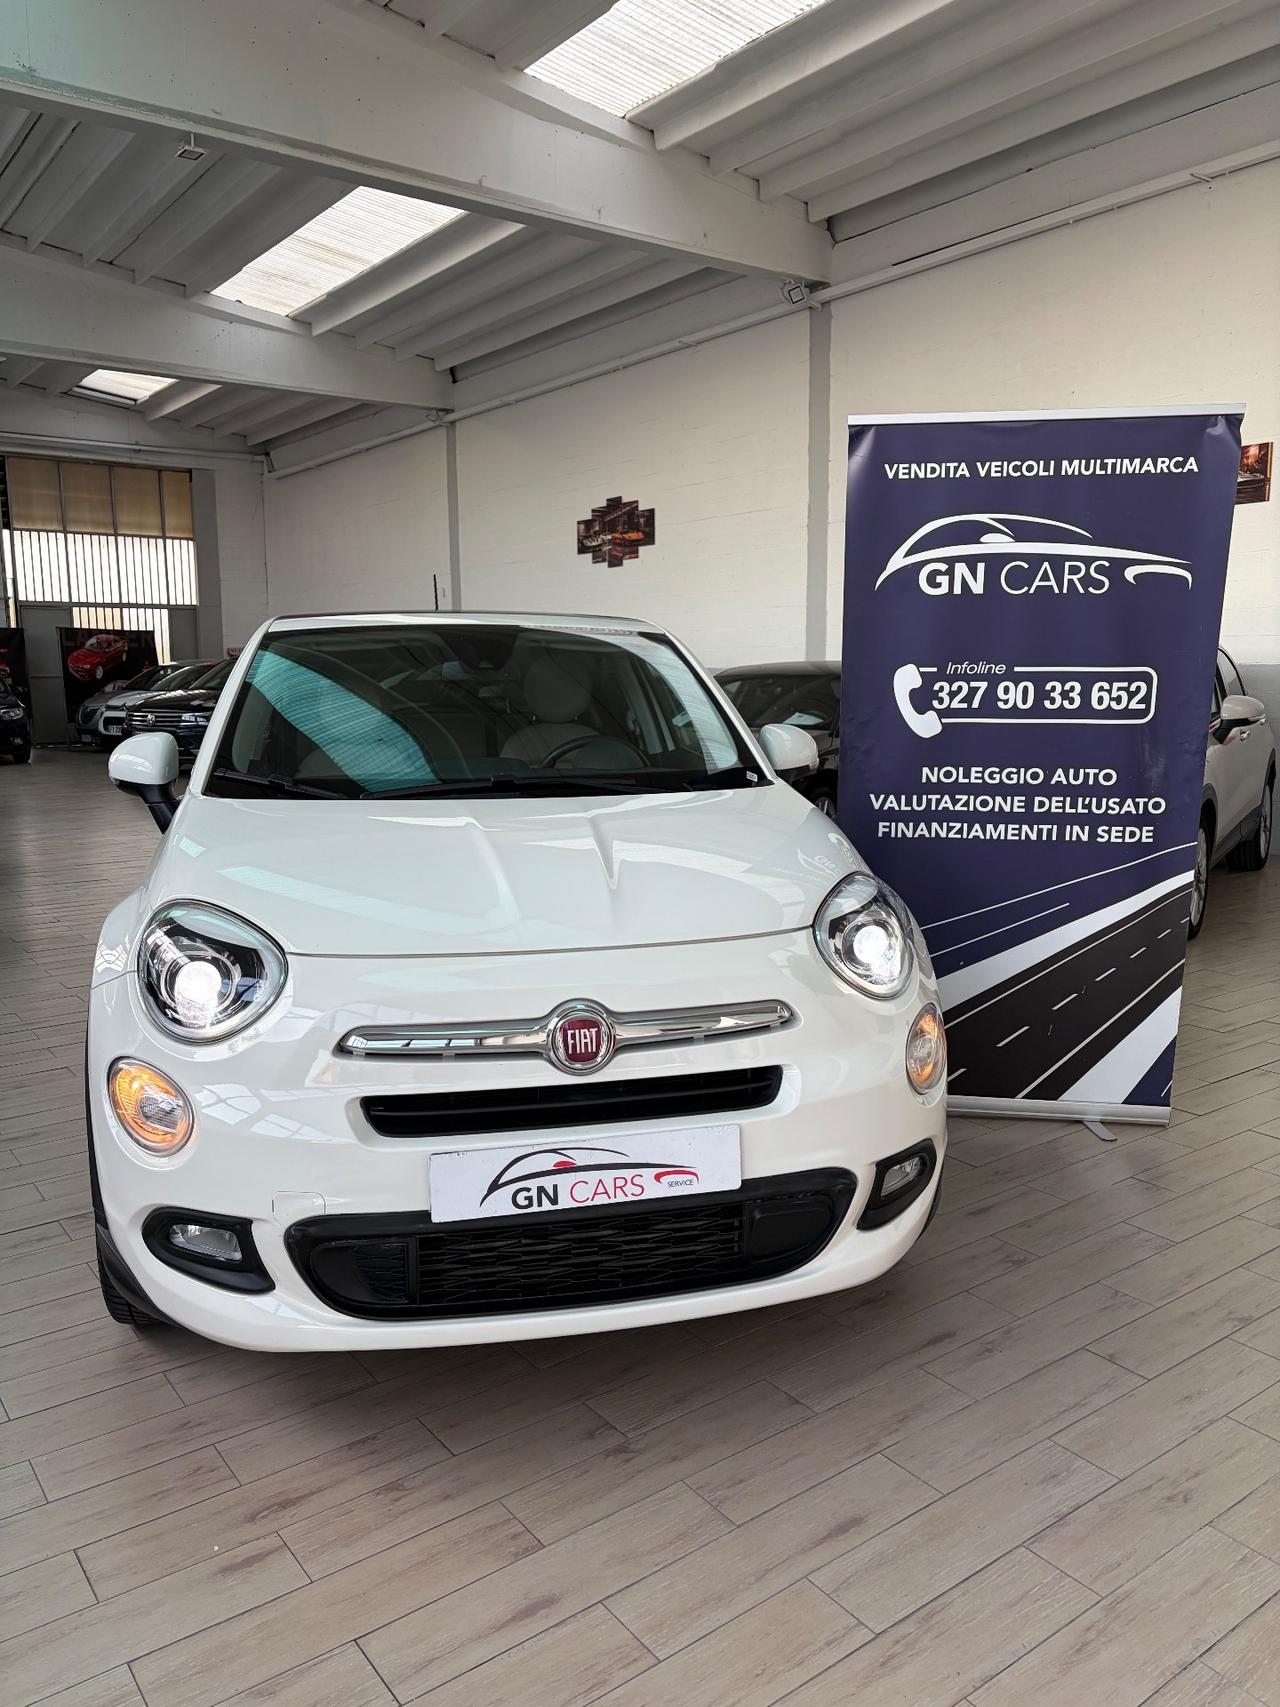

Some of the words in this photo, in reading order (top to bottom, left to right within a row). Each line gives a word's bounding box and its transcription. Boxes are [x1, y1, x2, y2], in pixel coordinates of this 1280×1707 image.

[884, 462, 970, 479] VENDITA
[976, 460, 1054, 478] VEICOLI
[1061, 456, 1198, 476] MULTIMARCA
[918, 562, 985, 595] GN
[1000, 560, 1110, 595] CARS
[946, 661, 1006, 675] Infoline
[931, 681, 988, 710] 327
[997, 681, 1034, 709] 90
[1044, 681, 1081, 710] 33
[1091, 681, 1147, 710] 652
[921, 766, 1044, 785] NOLEGGIO
[1051, 768, 1117, 786] AUTO
[870, 794, 1025, 813] VALUTAZIONE
[1034, 797, 1165, 815] DELL'USATO
[878, 822, 1057, 841] FINANZIAMENTI
[1066, 825, 1089, 842] IN
[1097, 826, 1154, 843] SEDE
[567, 1028, 598, 1055] FIAT
[511, 1184, 559, 1210] GN
[569, 1174, 646, 1204] CARS
[667, 1179, 694, 1188] SERVICE
